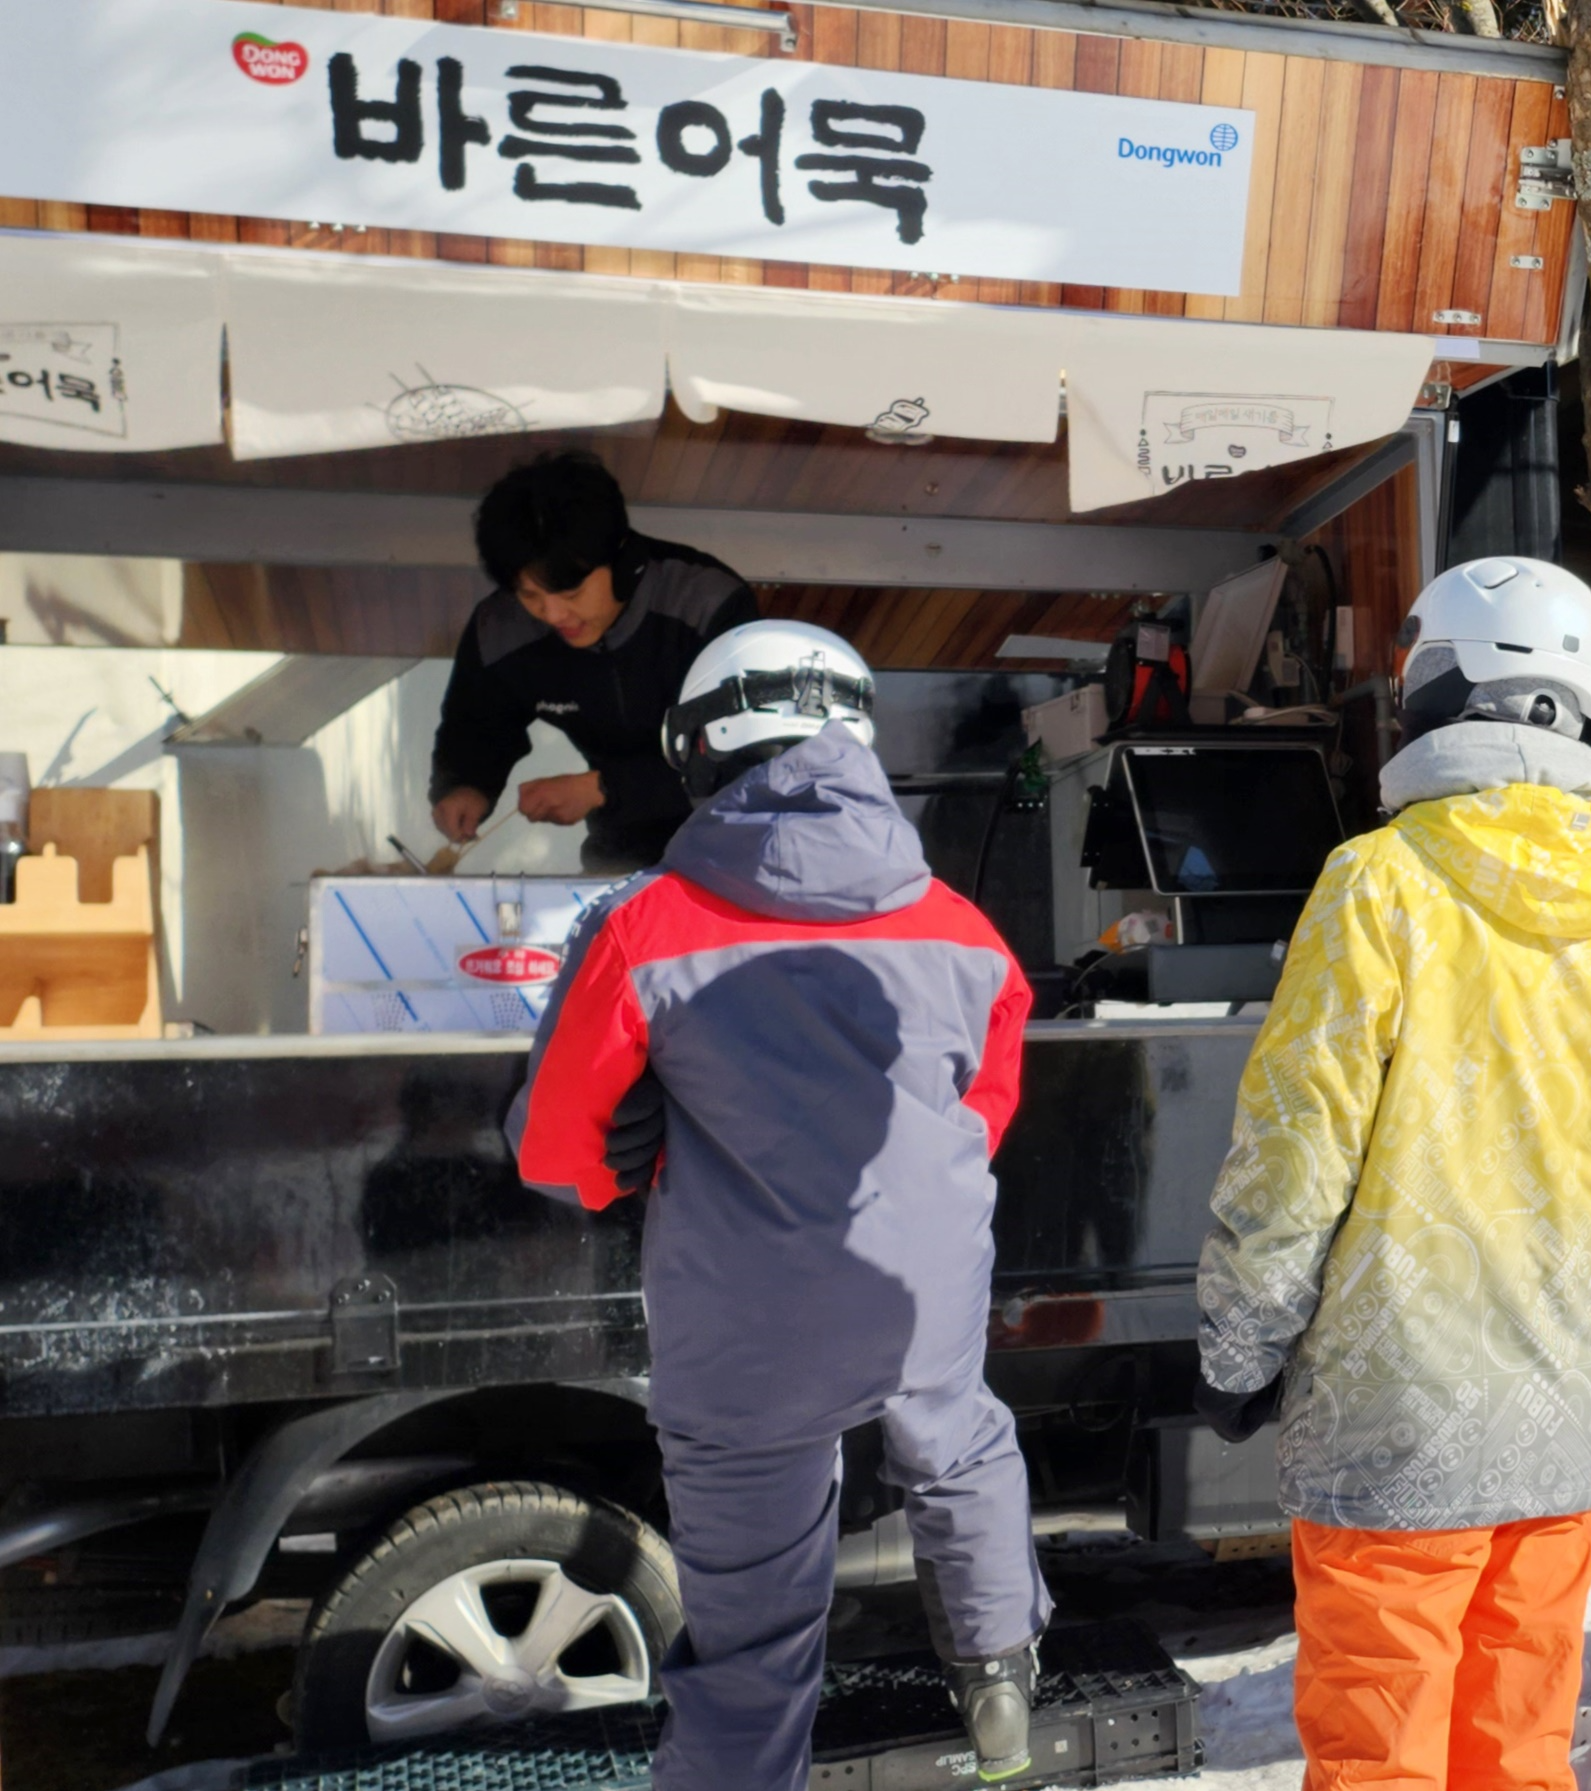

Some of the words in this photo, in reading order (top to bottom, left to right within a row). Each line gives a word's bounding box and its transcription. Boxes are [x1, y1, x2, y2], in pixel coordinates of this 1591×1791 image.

[242, 44, 300, 66] DONG
[249, 62, 295, 79] WON
[328, 51, 933, 245] 바른어묵
[1118, 137, 1222, 168] Dongwon
[1515, 1383, 1564, 1438] FUBU
